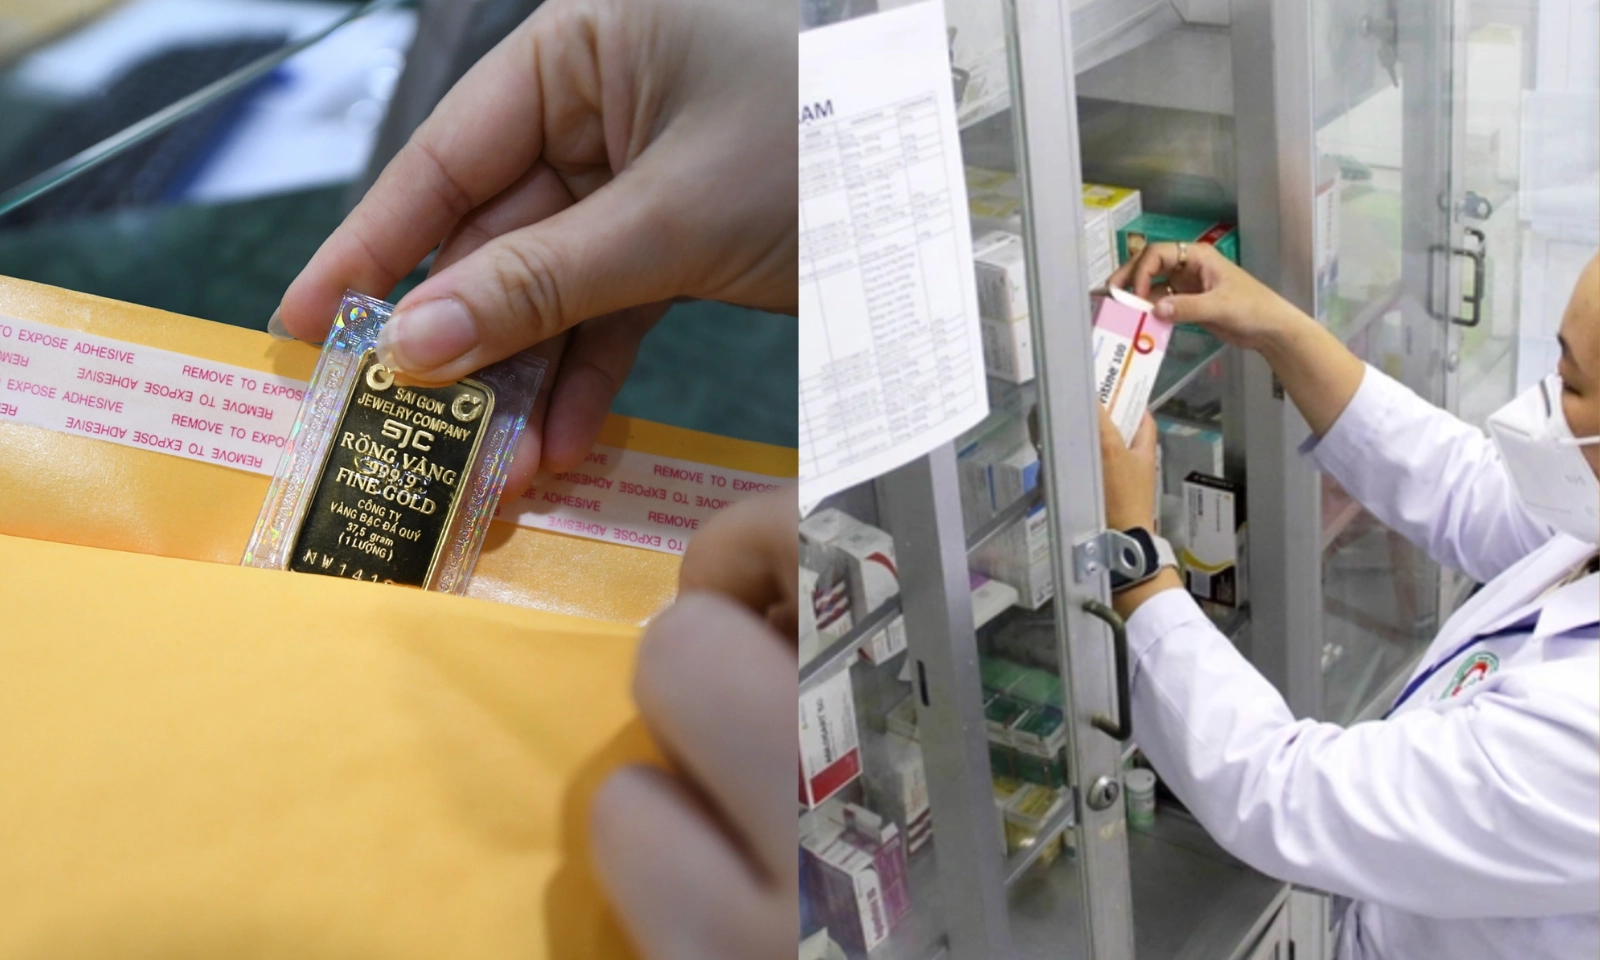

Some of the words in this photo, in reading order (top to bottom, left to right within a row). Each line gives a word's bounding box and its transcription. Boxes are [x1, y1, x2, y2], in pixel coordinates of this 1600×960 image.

[798, 99, 834, 127] ẠM
[18, 329, 68, 349] EXPOSE
[73, 342, 135, 364] ADHESIVE
[77, 367, 138, 390] ADHESIVE
[182, 365, 234, 386] REMOVE
[240, 377, 257, 391] TO
[262, 382, 306, 402] EXPOS
[7, 378, 57, 399] EXPOSE
[62, 391, 124, 413] ADHESIVE
[144, 380, 193, 402] EXPOSE
[199, 394, 215, 407] TO
[395, 388, 417, 404] SAI
[416, 395, 446, 415] GON
[222, 398, 273, 420] REMOVE
[357, 392, 413, 420] JEWELRY
[412, 412, 471, 441] COMPANY
[65, 416, 127, 438] ADHESIVE
[171, 413, 224, 434] REMOVE
[230, 426, 246, 439] TO
[381, 419, 435, 452] SJC
[134, 430, 182, 451] EXPOSE
[188, 443, 204, 456] TO
[212, 447, 263, 468] REMOVE
[340, 431, 398, 463] RỒNG
[402, 453, 457, 485] VÀNG
[555, 472, 613, 490] ADHESIVE
[653, 464, 704, 483] REMOVE
[711, 475, 727, 487] TO
[336, 467, 380, 495] FINE
[382, 485, 437, 515] GOLD
[619, 481, 667, 499] EXPOSE
[673, 492, 689, 504] TO
[357, 499, 386, 517] CÔNG
[388, 509, 402, 522] TY
[542, 493, 601, 512] ADHESIVE
[330, 501, 357, 519] VÀNG
[359, 512, 381, 527] BẠC
[382, 521, 399, 534] ĐÁ
[398, 527, 421, 542] QUÝ
[548, 516, 607, 536] ADHESIVE
[648, 511, 699, 530] REMOVE
[346, 522, 367, 537] 37,5
[369, 532, 394, 547] gram
[613, 528, 661, 547] EXPOSE
[668, 539, 684, 551] TO
